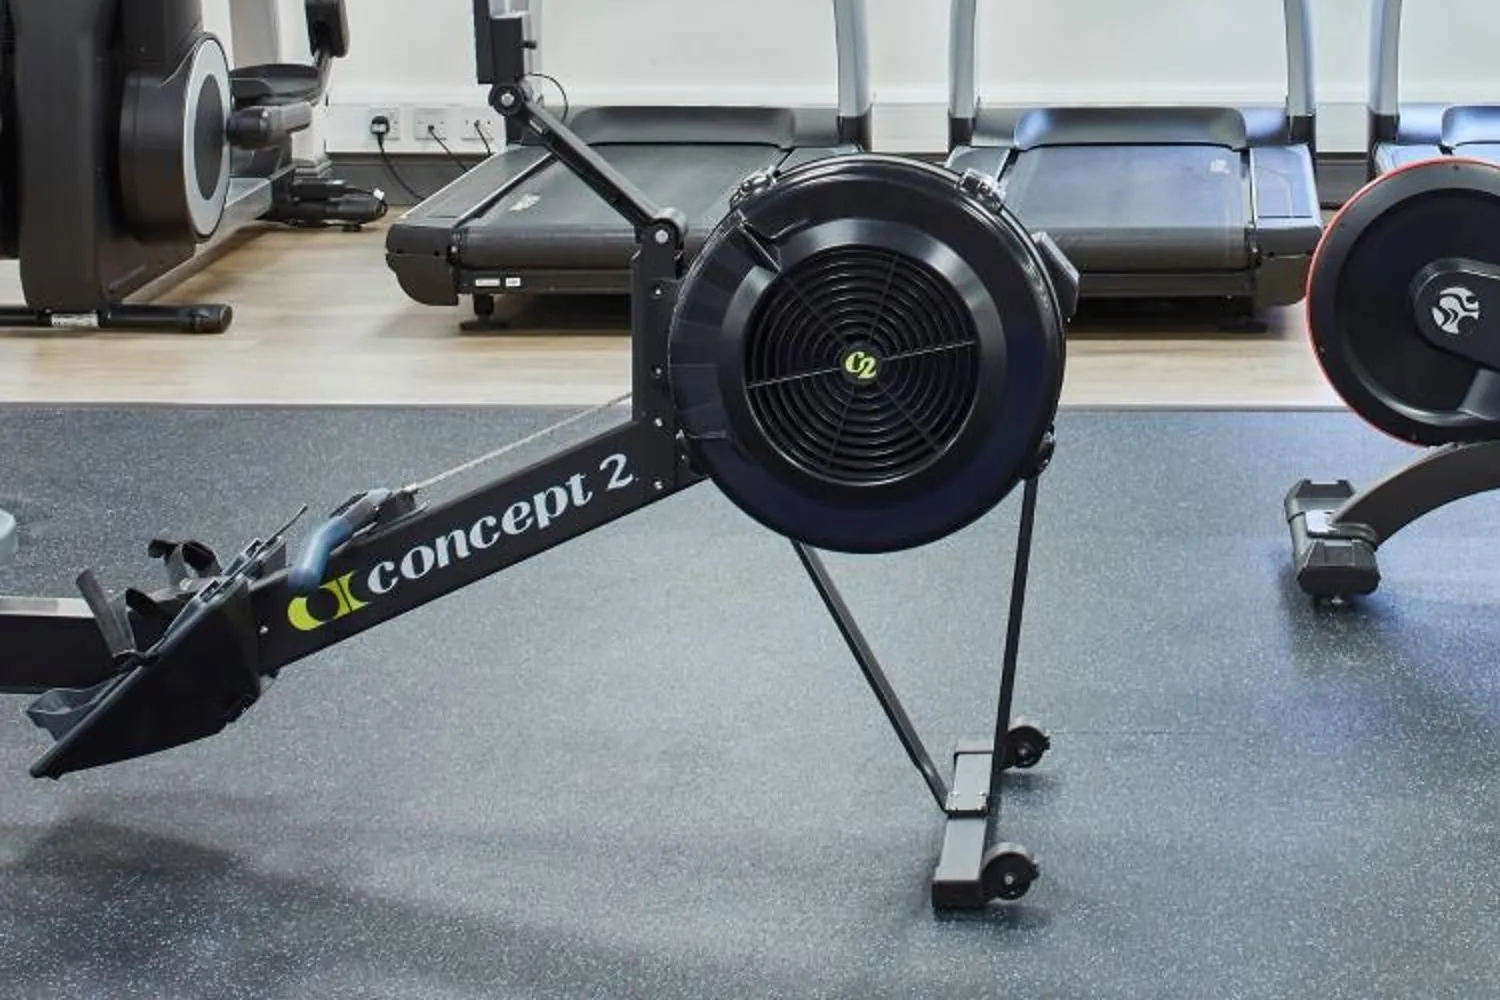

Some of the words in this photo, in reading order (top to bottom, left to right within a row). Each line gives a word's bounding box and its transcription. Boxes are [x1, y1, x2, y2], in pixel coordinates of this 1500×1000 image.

[845, 351, 876, 379] C2
[366, 471, 593, 596] concept
[599, 452, 634, 493] 2
